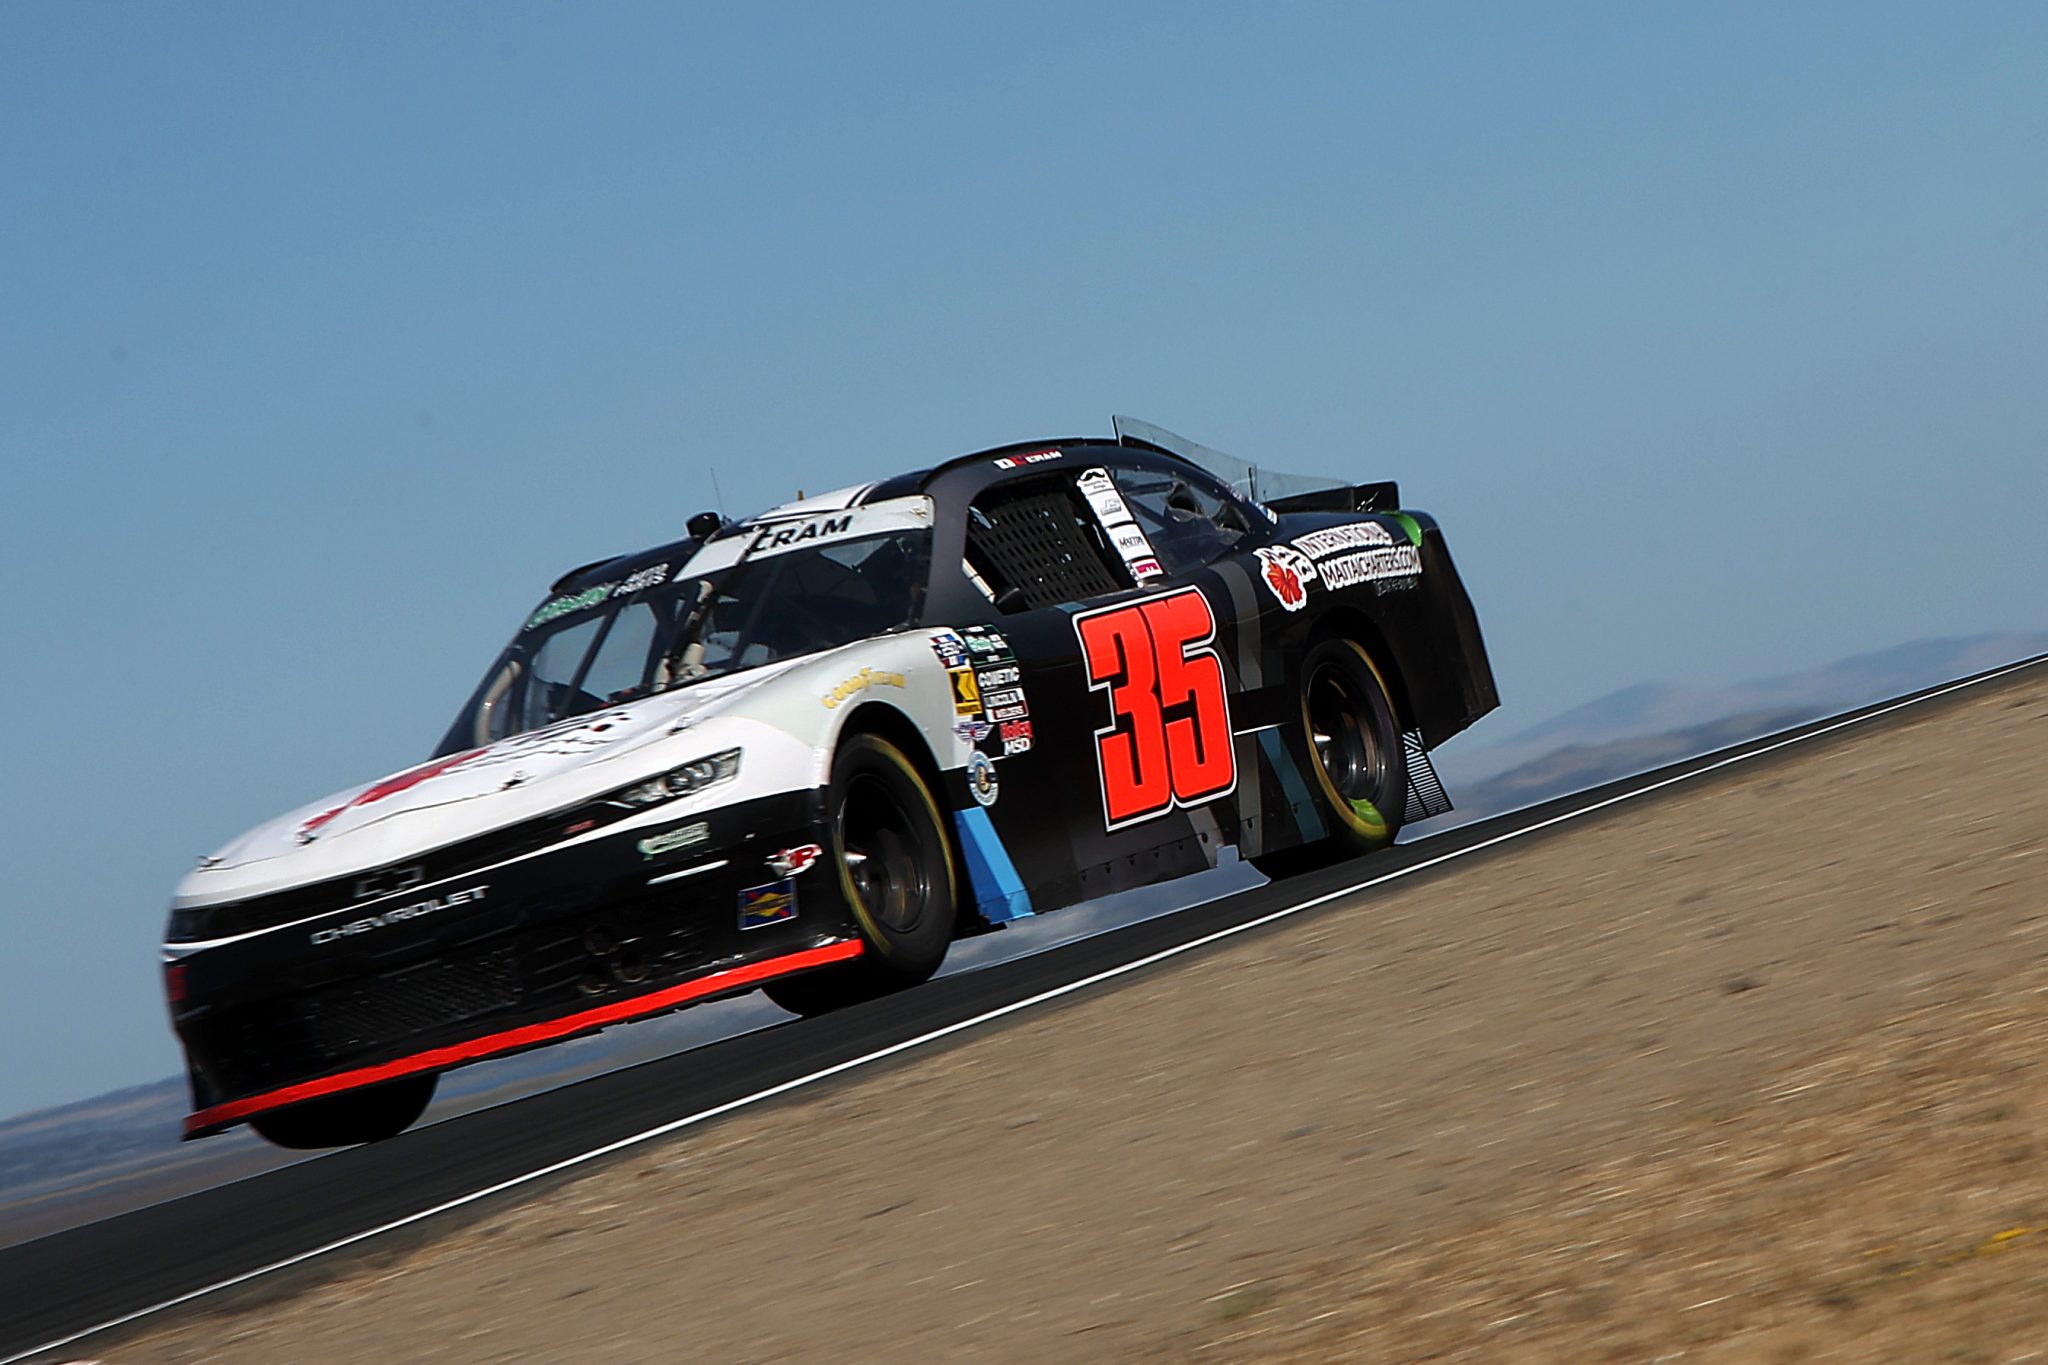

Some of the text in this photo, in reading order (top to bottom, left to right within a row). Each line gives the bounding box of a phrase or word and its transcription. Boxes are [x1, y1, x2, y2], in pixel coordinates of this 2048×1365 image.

[1297, 522, 1392, 557] INTERNATIONAL
[1074, 587, 1236, 829] 35
[1004, 737, 1031, 755] MSD
[310, 885, 490, 944] CHEVROLET
